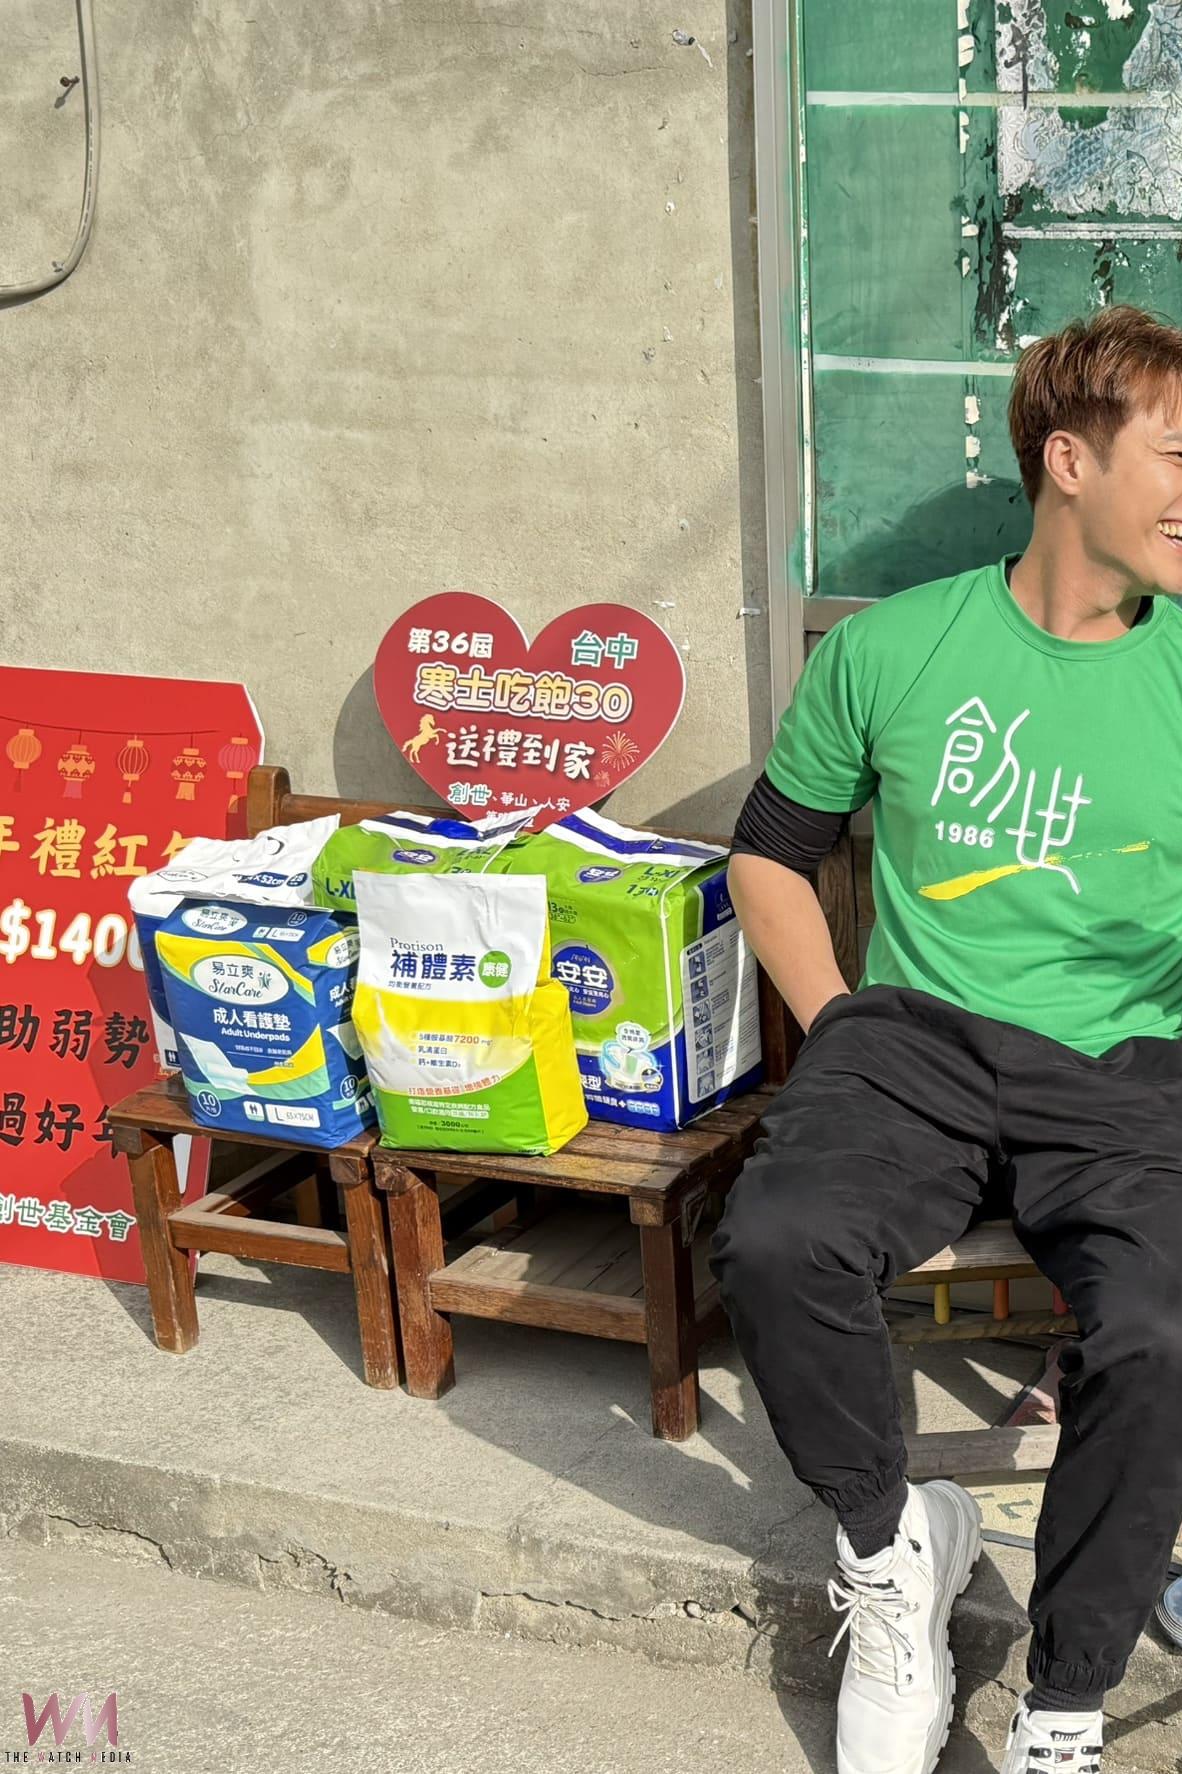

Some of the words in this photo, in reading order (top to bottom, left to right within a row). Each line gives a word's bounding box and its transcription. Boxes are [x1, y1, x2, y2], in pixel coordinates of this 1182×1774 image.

[407, 627, 494, 659] 第36屆
[571, 630, 639, 669] 台中
[414, 662, 633, 723] 寒士吃飽30
[446, 725, 595, 780] 送禮到家
[935, 820, 995, 848] 1986
[390, 937, 444, 952] Protison
[212, 961, 254, 979] 易立爽
[390, 950, 476, 982] 補體素
[481, 962, 509, 978] 康健
[556, 960, 608, 989] 安安
[208, 979, 263, 999] StarCare
[213, 1008, 291, 1031] 成人看護墊
[221, 1027, 243, 1037] Adult
[244, 1028, 291, 1042] Underpads
[201, 1093, 216, 1107] 10
[274, 1107, 284, 1121] L
